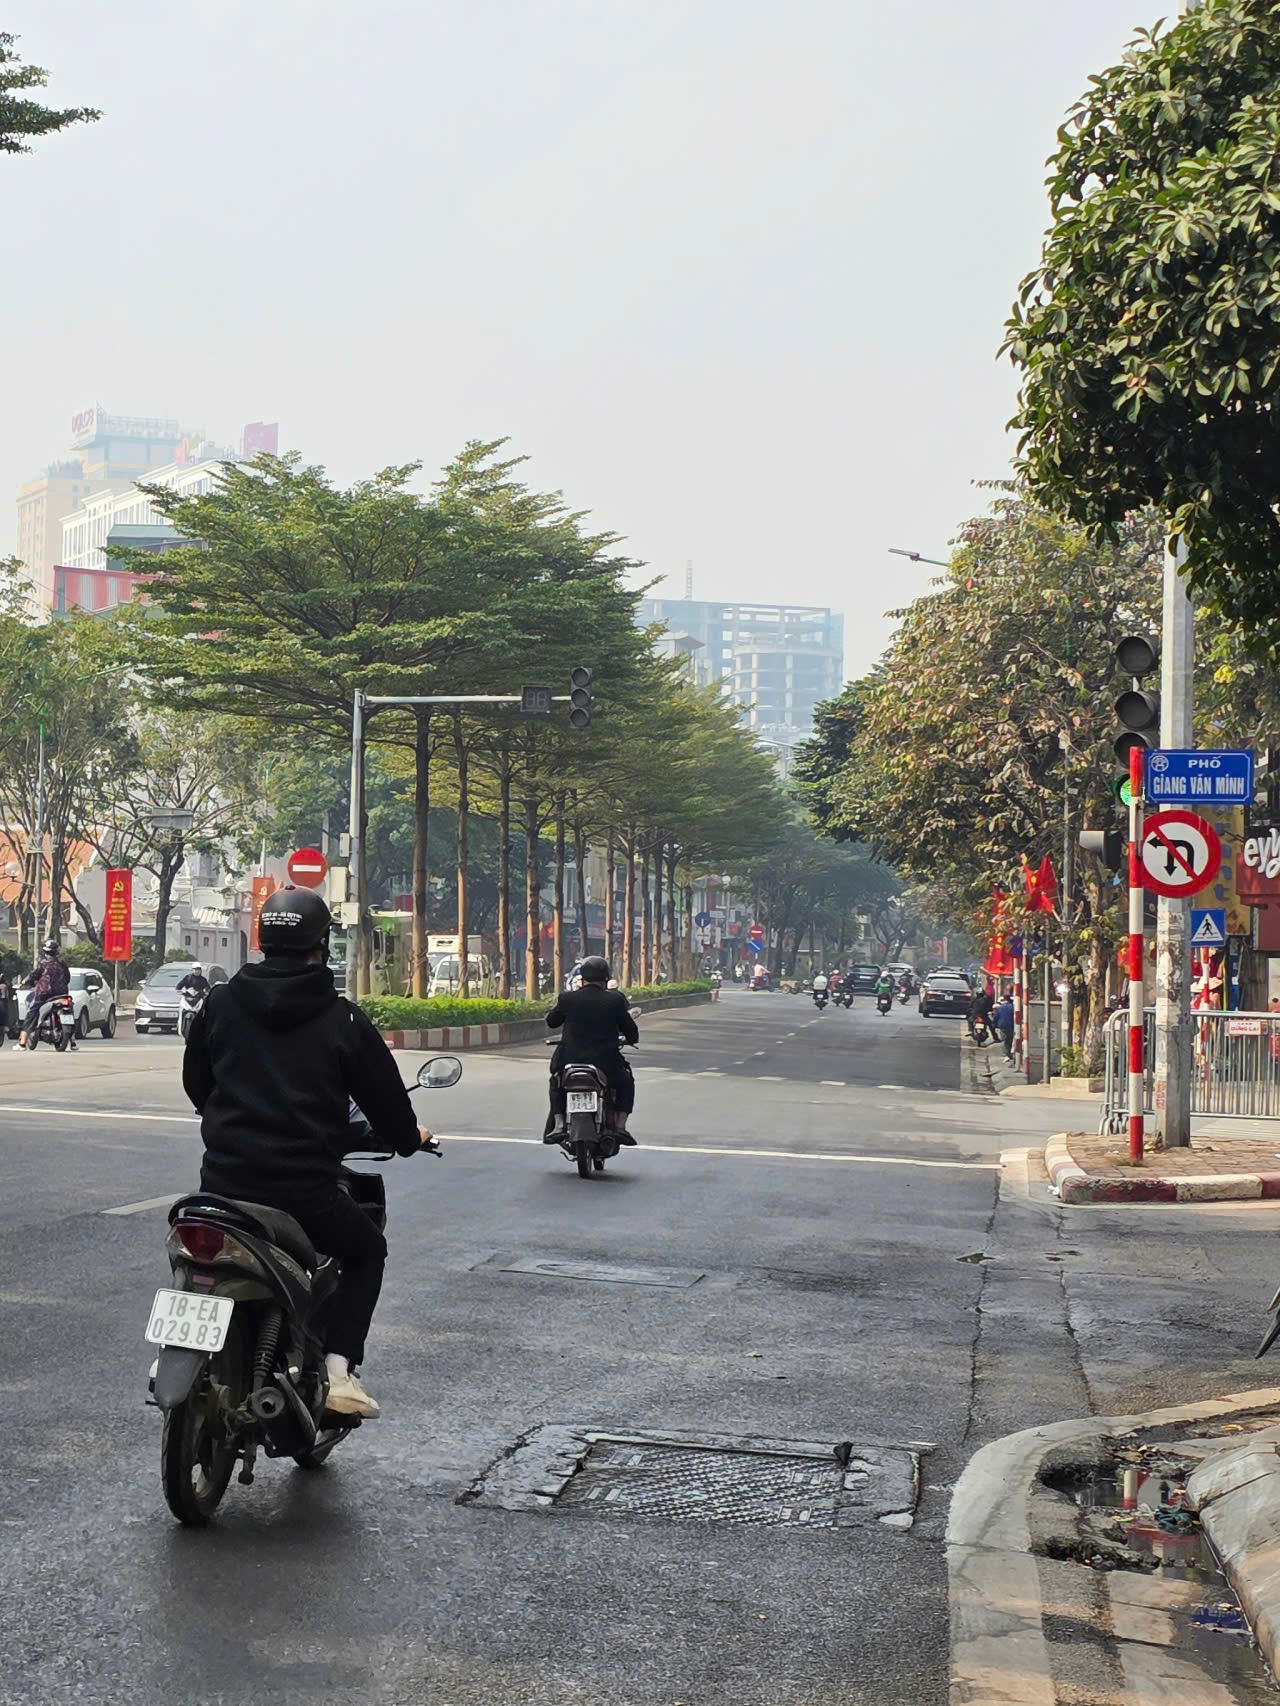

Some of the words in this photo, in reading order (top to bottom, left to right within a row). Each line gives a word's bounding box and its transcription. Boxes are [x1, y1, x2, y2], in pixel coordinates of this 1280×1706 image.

[1188, 755, 1222, 769] PHỐ
[1189, 773, 1212, 795] VĂN
[168, 1295, 220, 1323] 18-EA
[151, 1318, 222, 1348] 029.83
